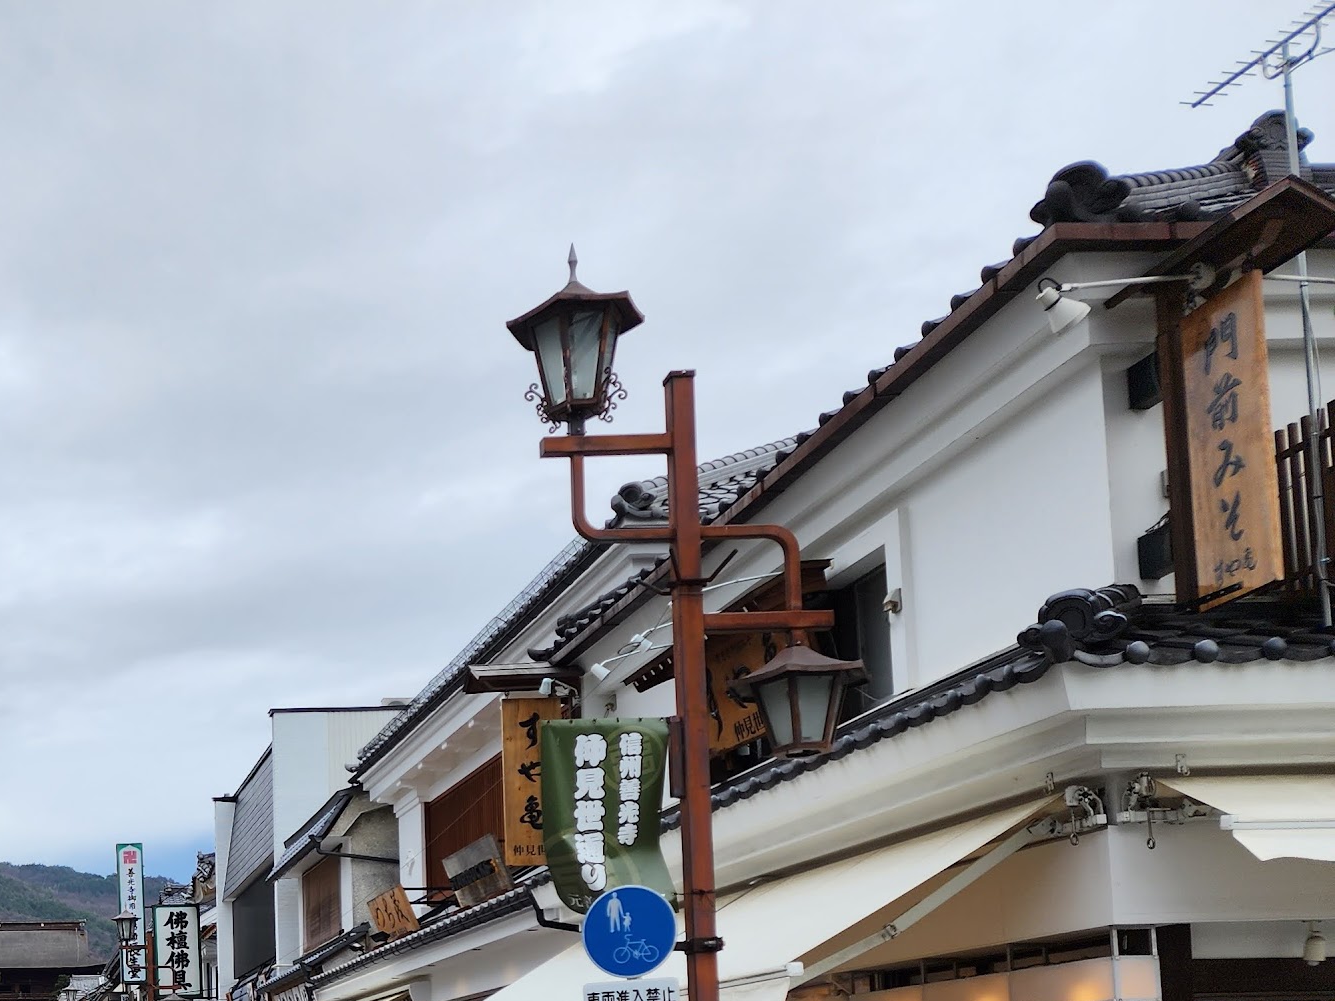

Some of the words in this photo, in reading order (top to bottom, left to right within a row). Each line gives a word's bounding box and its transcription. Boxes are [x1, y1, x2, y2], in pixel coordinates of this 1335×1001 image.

[1202, 311, 1246, 542] 門前みそ
[573, 732, 608, 892] 仲見世通り
[618, 731, 643, 847] 信州善光寺
